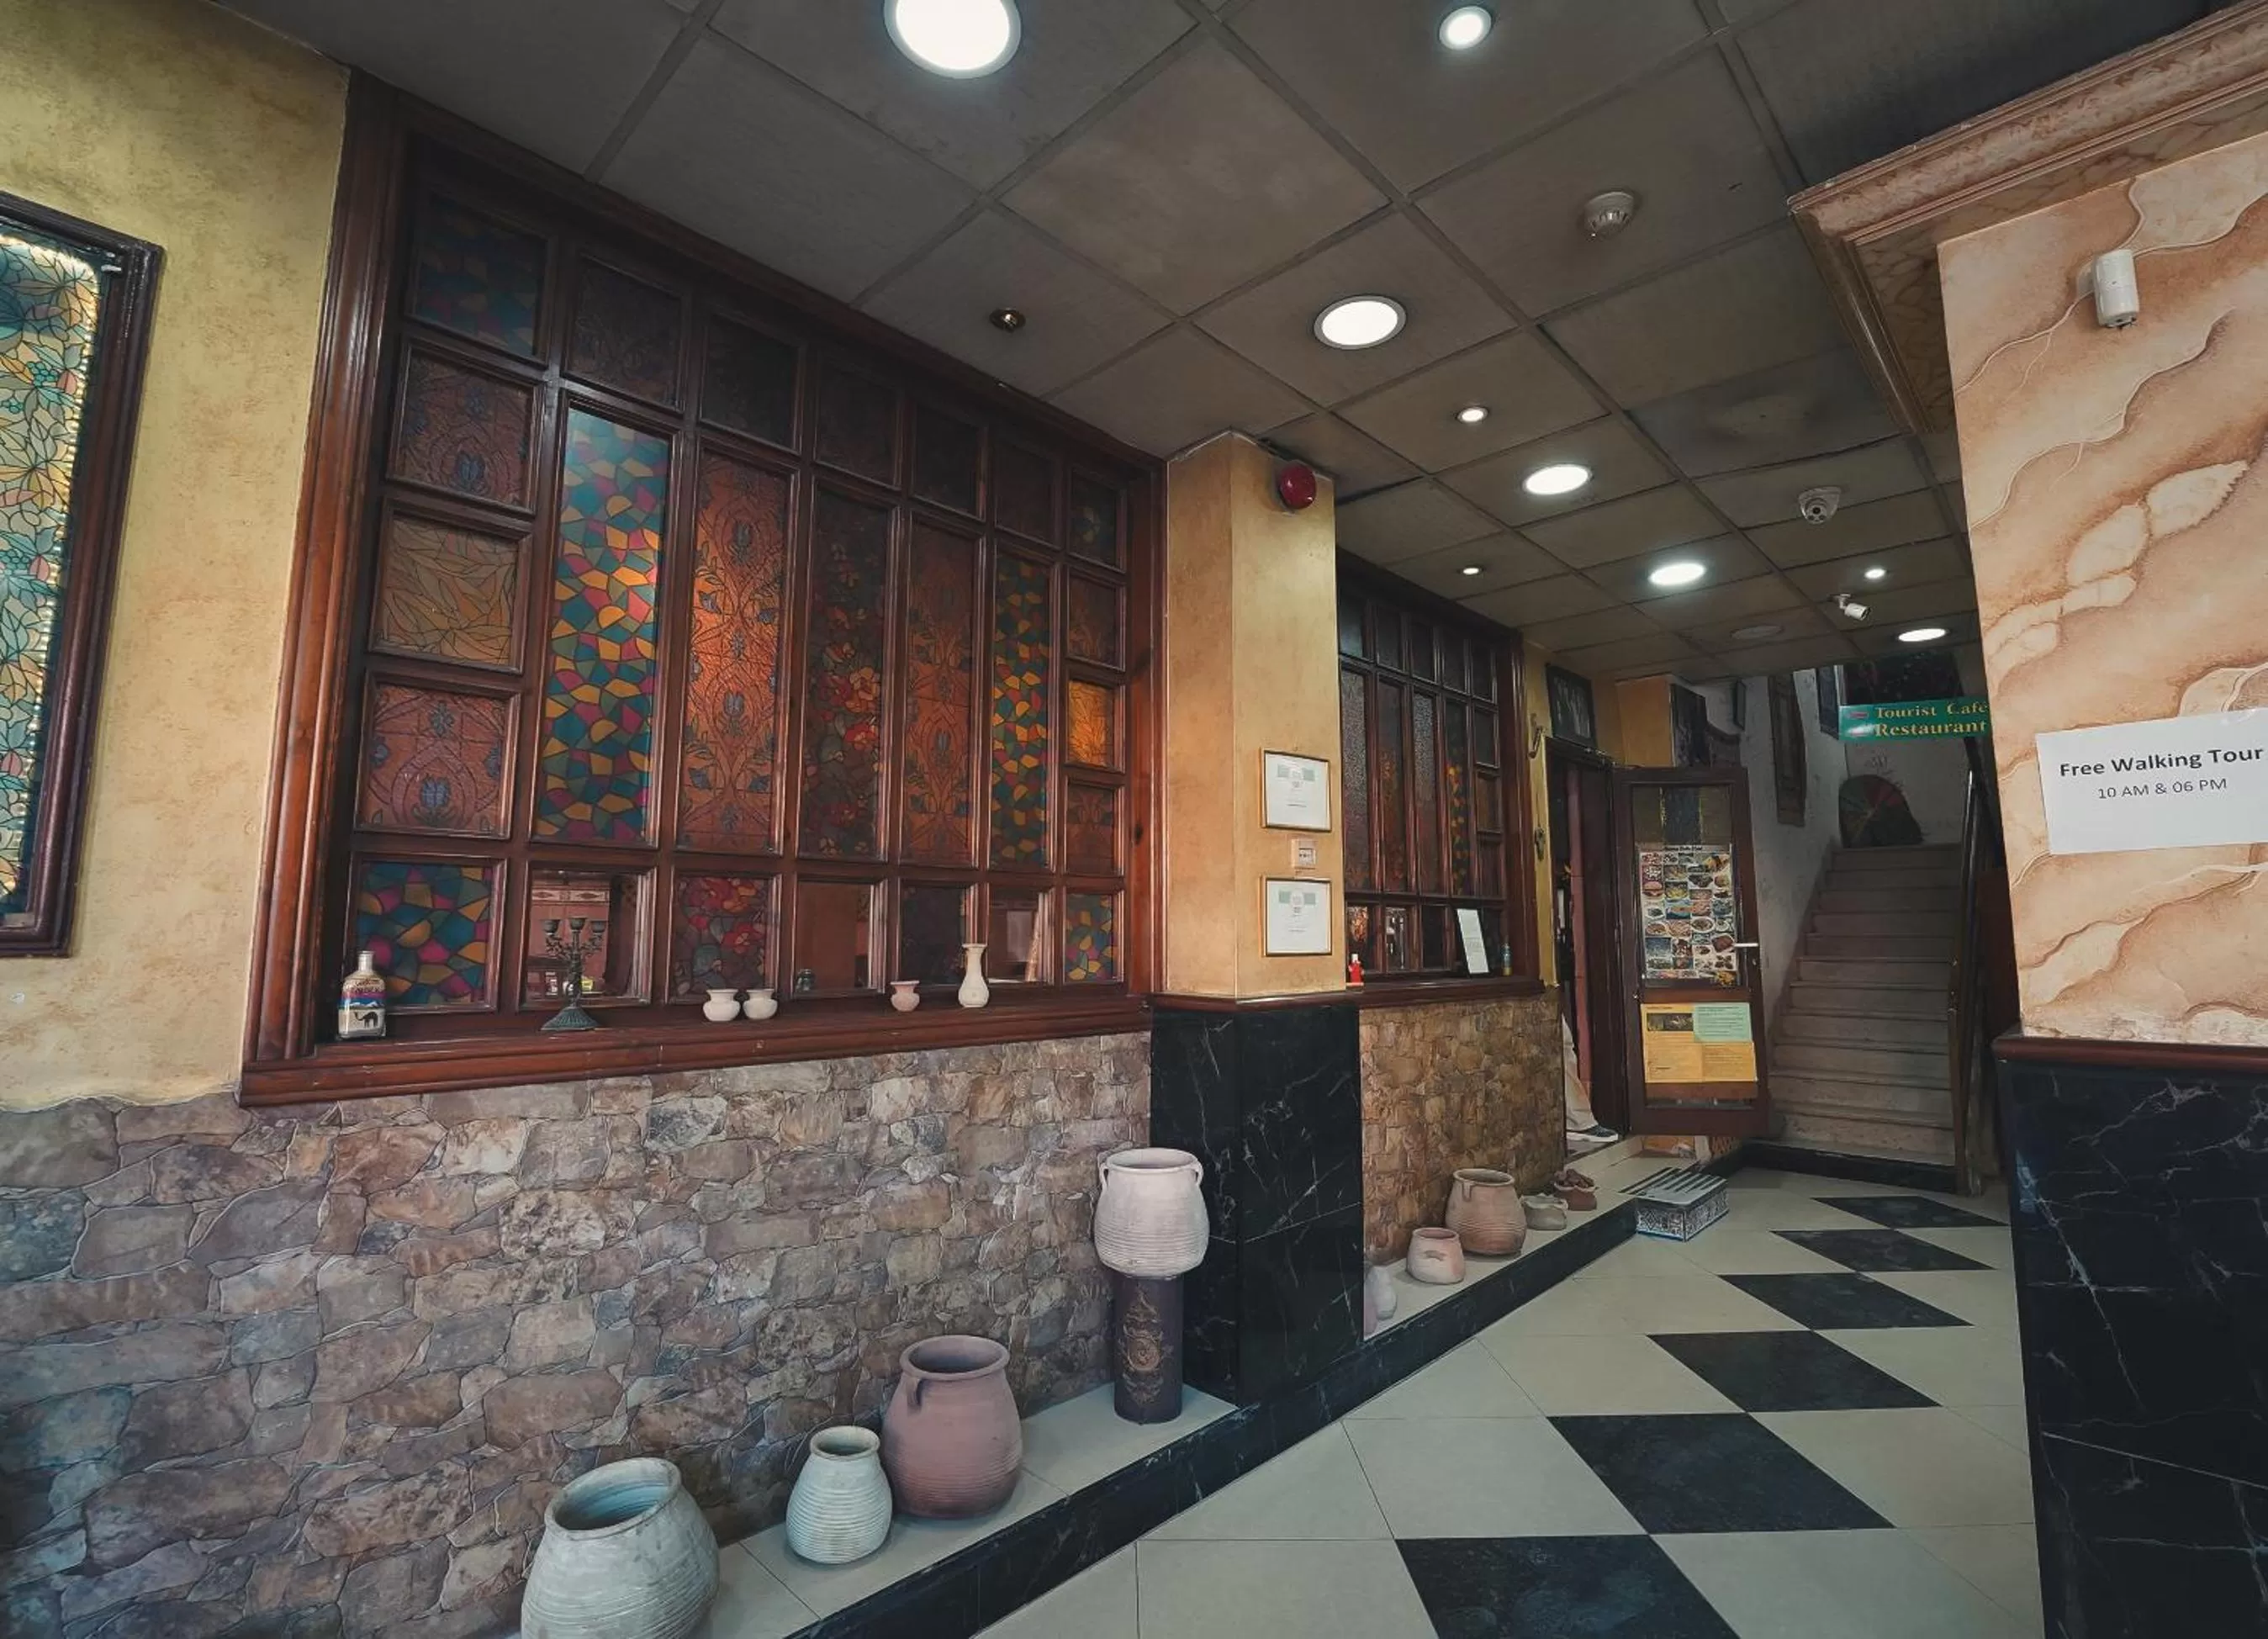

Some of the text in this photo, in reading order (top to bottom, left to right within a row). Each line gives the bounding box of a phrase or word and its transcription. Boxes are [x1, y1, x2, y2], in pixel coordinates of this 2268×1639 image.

[1875, 706, 1937, 719] Tourist
[1875, 720, 1986, 737] Restaurant
[2060, 748, 2264, 777] Free Walking Tour
[2098, 778, 2227, 799] 10 AM & 06 PM
